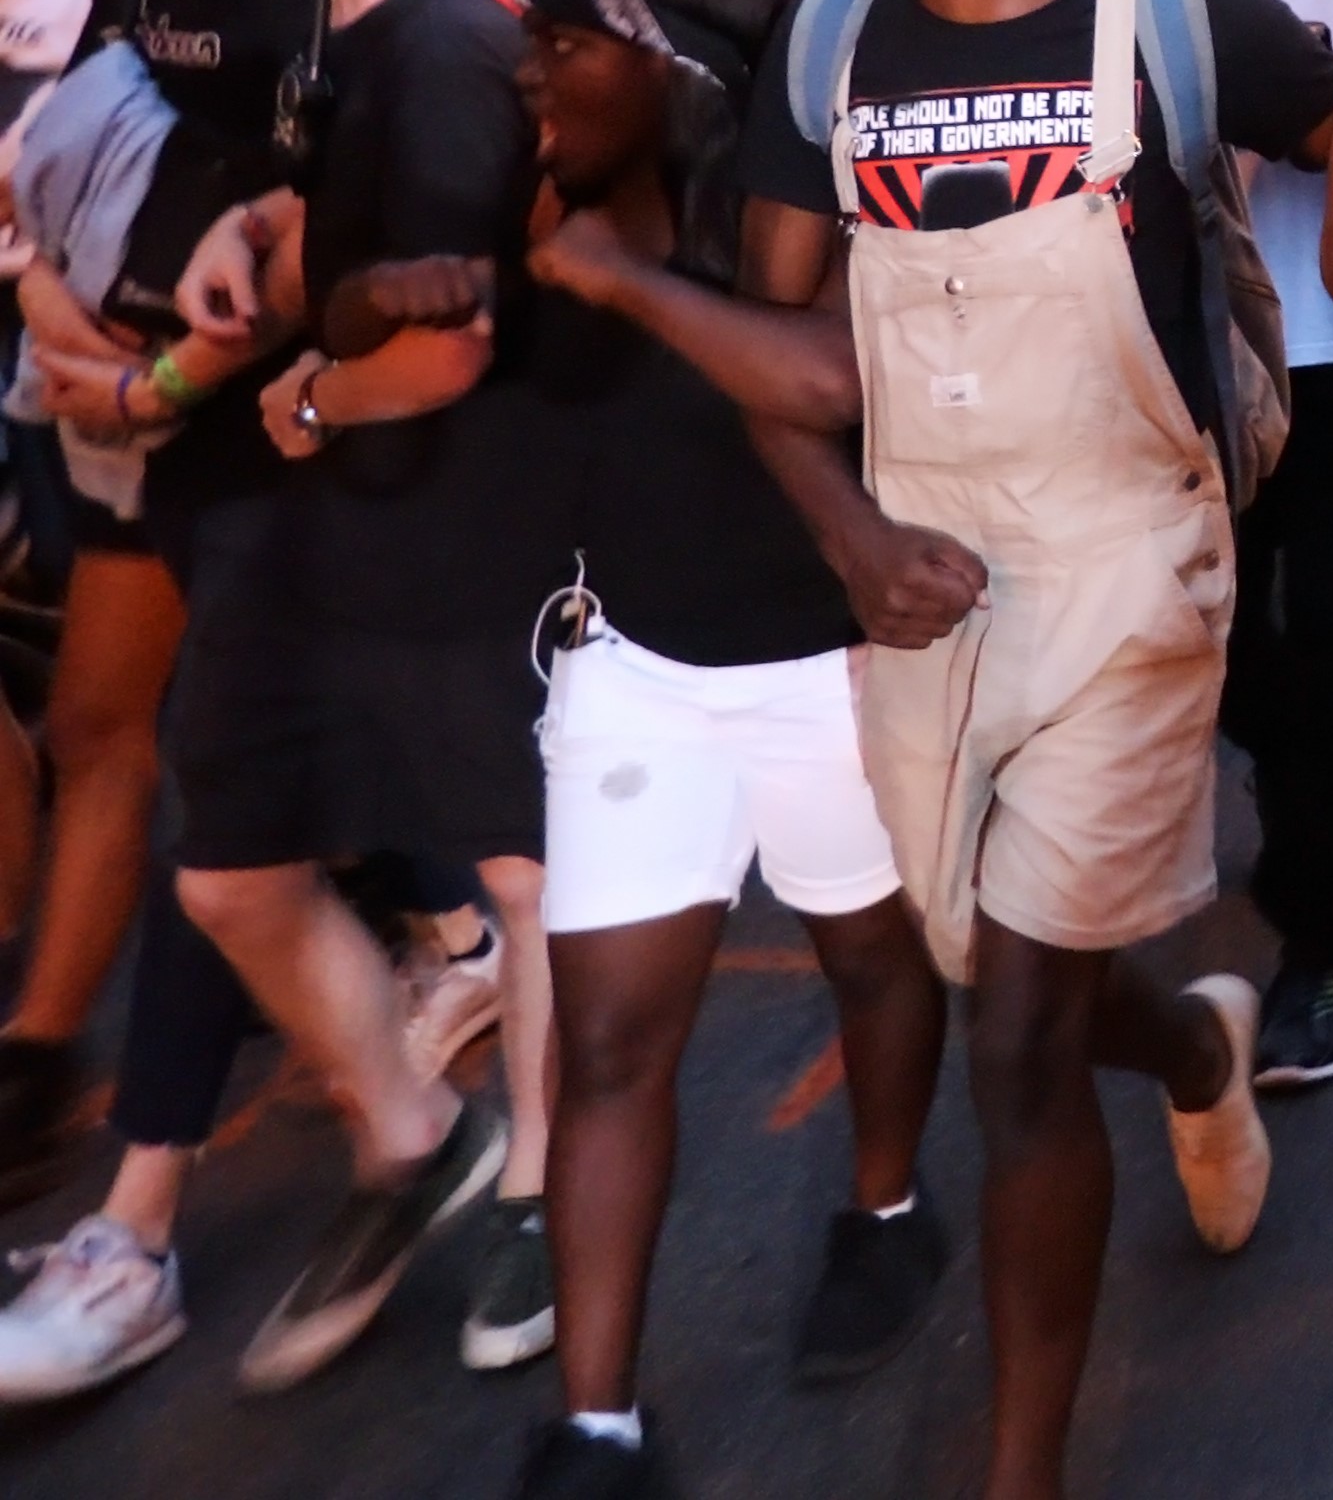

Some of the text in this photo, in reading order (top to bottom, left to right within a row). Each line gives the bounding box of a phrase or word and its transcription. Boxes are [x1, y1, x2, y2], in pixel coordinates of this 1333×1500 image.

[894, 97, 968, 127] SHOULD
[974, 94, 1015, 121] NOT
[1021, 92, 1050, 117] BE
[881, 127, 935, 156] THEIR
[941, 116, 1093, 153] GOVERNMENTS
